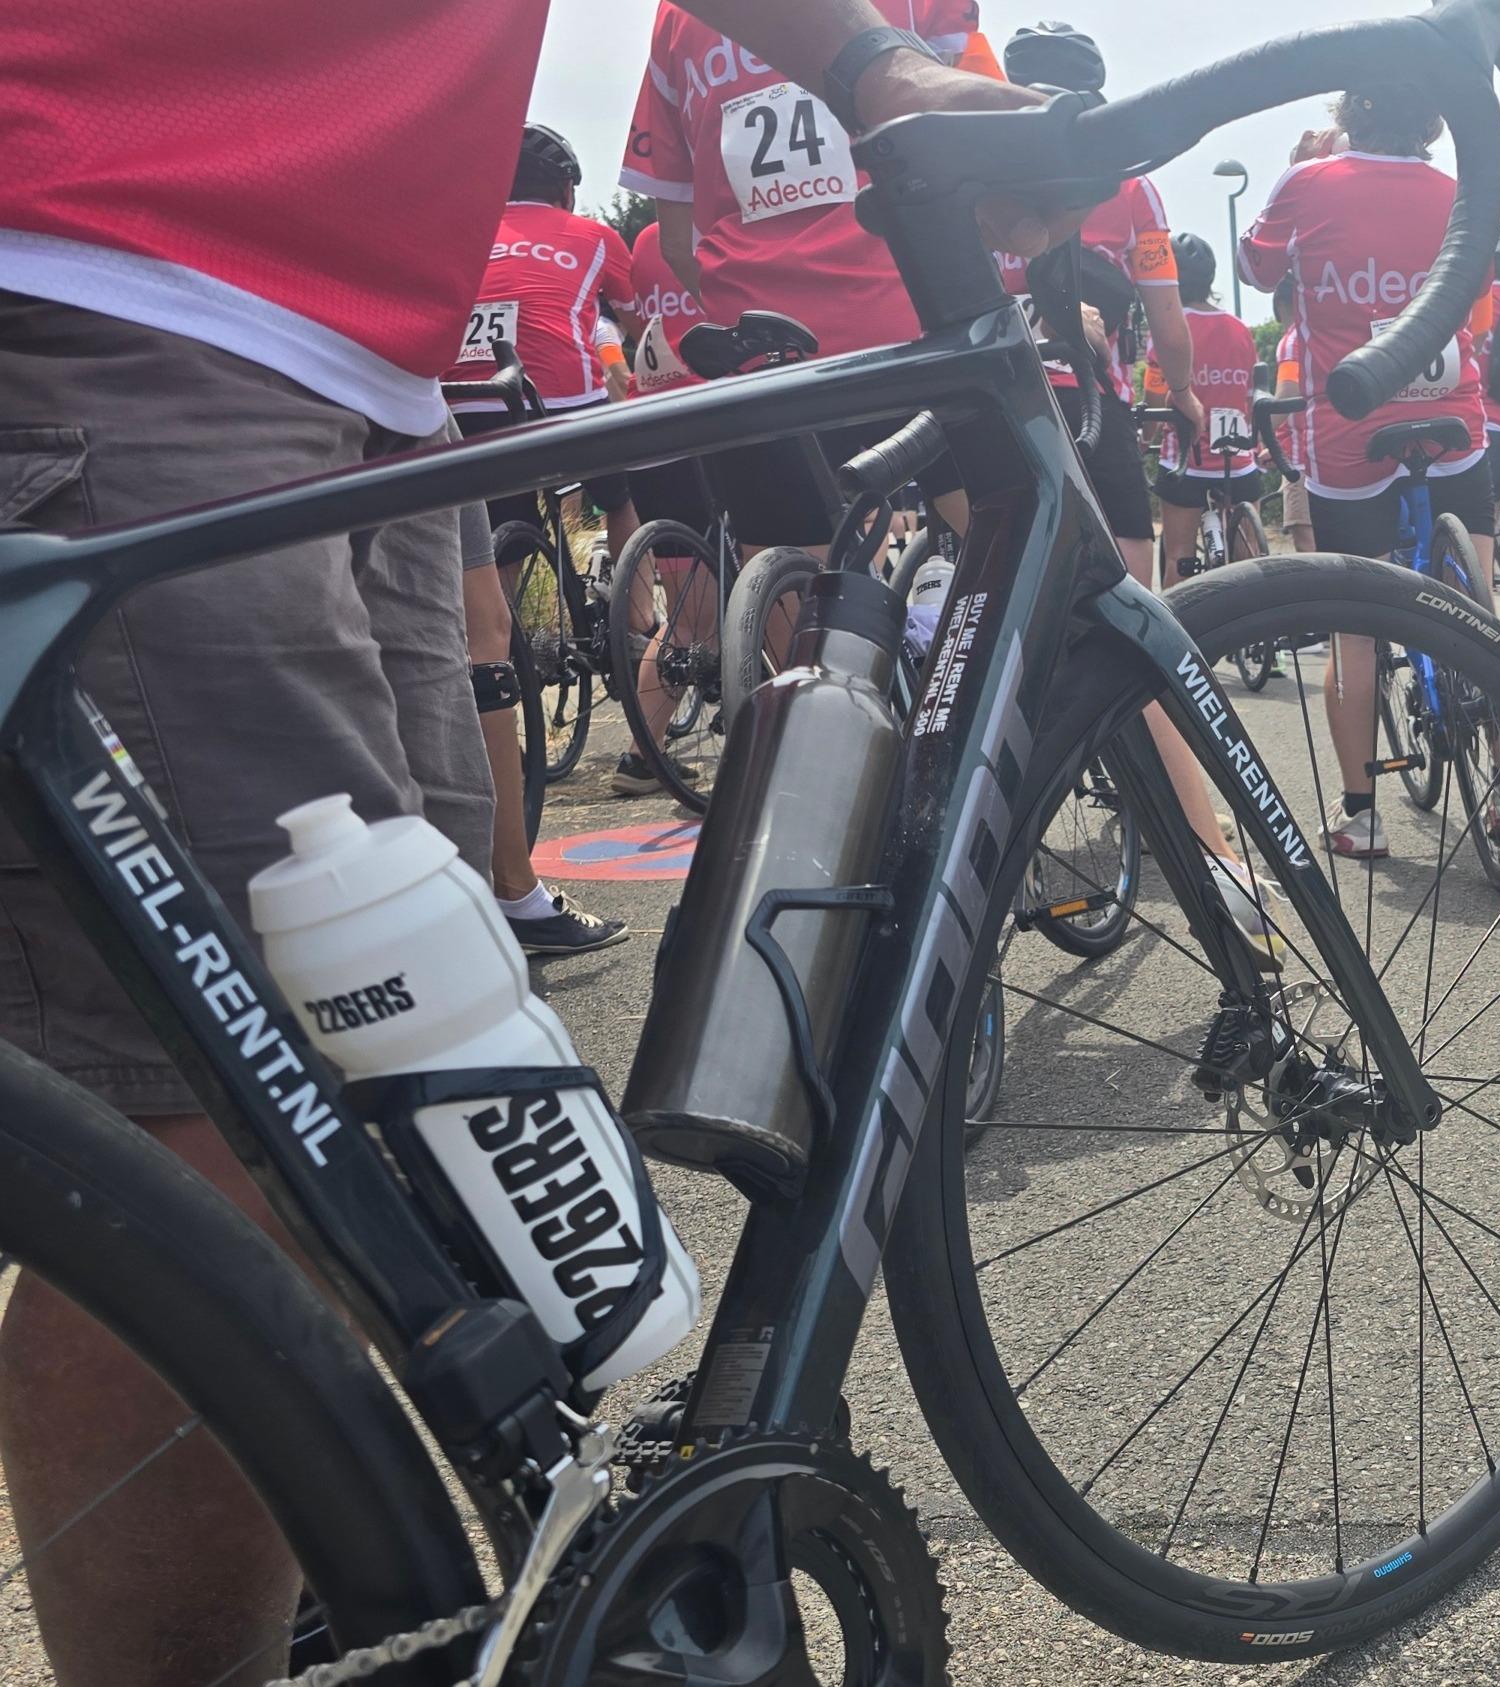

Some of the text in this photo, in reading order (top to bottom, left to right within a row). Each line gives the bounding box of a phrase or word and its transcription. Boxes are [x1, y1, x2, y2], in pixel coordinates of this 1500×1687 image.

[744, 98, 826, 178] 24
[748, 175, 844, 212] Adecco
[489, 241, 579, 270] ecco
[1313, 257, 1431, 304] Adec
[466, 312, 506, 346] 25
[460, 347, 493, 359] Adec
[643, 329, 659, 371] 6
[1192, 363, 1249, 387] decco
[1396, 384, 1450, 399] decco
[967, 591, 988, 624] BUY
[924, 594, 969, 705] WIEL-RENT.NL
[958, 627, 977, 652] ME
[943, 661, 966, 705] RENT
[914, 708, 932, 737] 300
[932, 707, 951, 733] ME
[1175, 650, 1311, 870] WIEL-RENT.NL
[71, 769, 344, 1168] WIEL-RENT.NL
[305, 972, 417, 1035] 226ERS
[1373, 1550, 1415, 1580] SHIMANO
[1250, 1628, 1315, 1646] 5000
